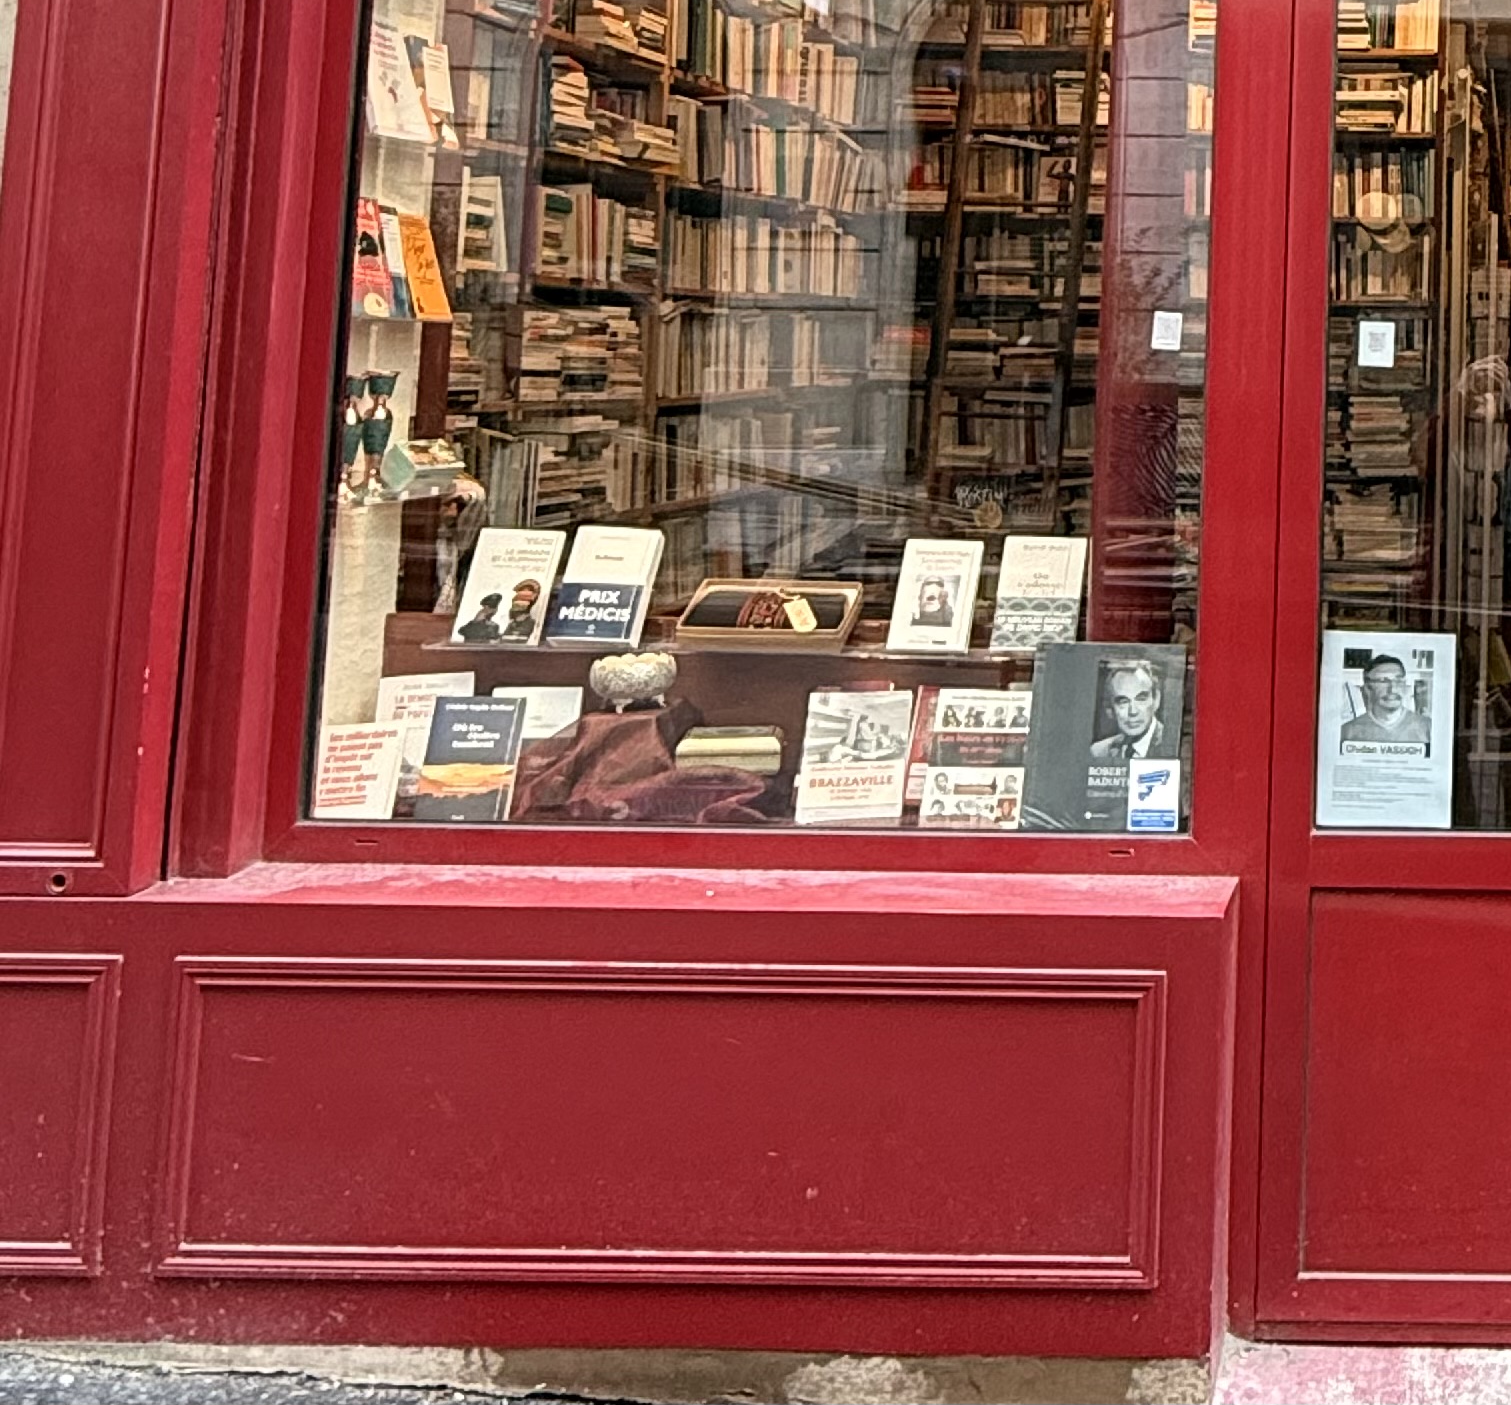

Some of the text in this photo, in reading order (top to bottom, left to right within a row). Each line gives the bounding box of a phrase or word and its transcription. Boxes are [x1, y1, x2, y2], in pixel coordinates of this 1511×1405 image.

[578, 589, 621, 604] PRIX
[558, 604, 631, 622] MÉDICIS
[1088, 766, 1127, 776] ROBERT
[809, 774, 893, 788] BRAZZAVILLE
[1087, 777, 1129, 787] BADINT
